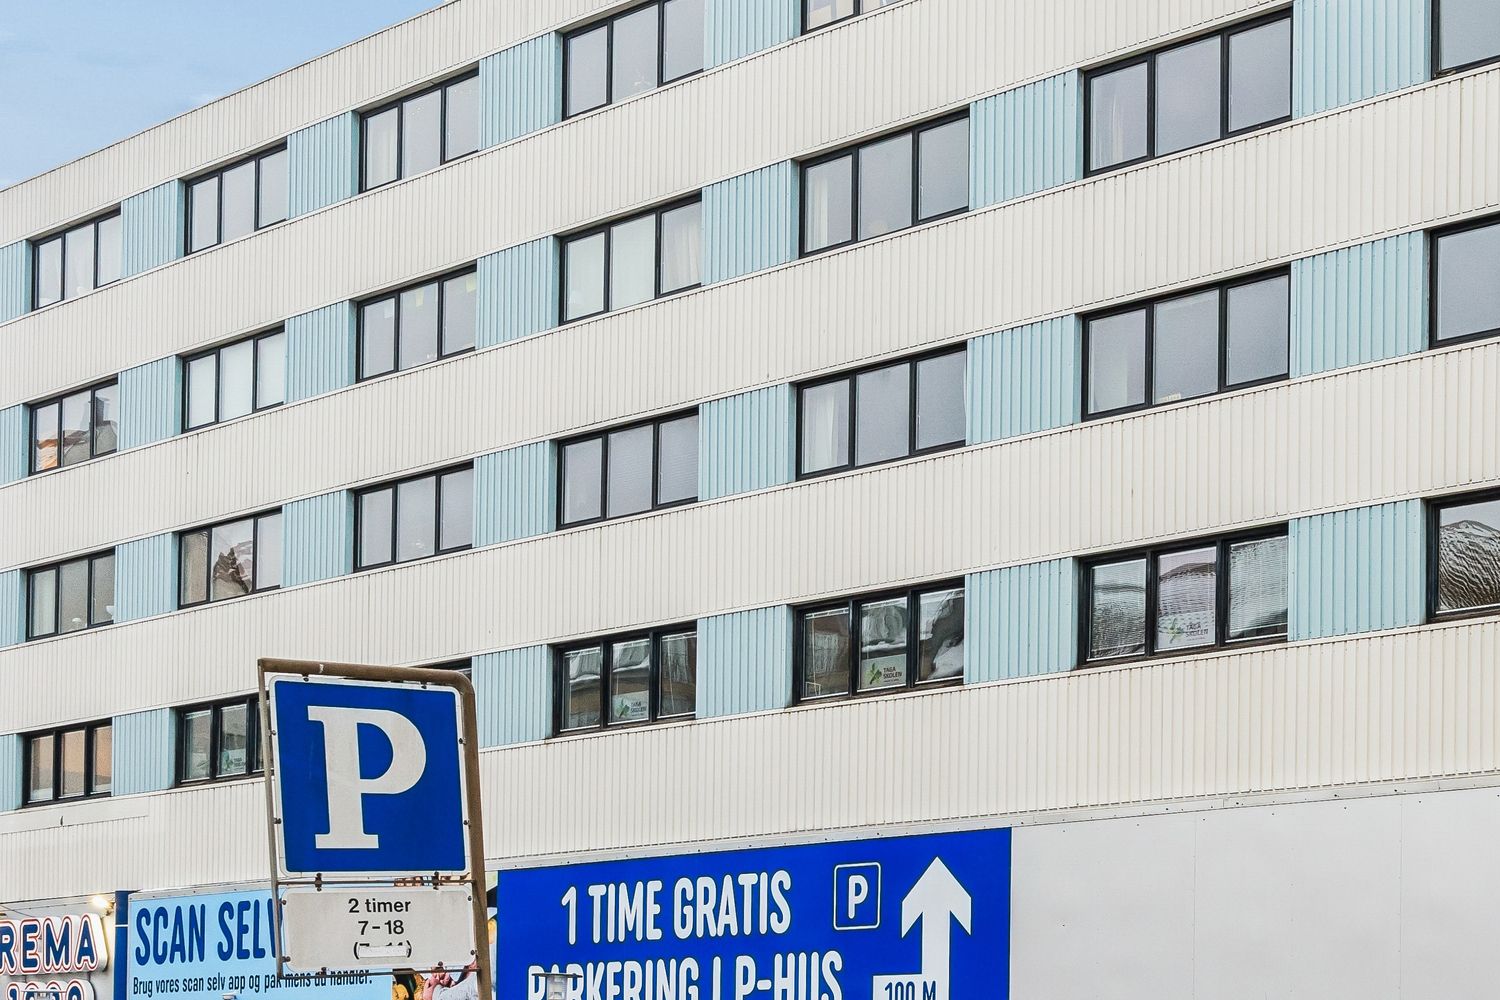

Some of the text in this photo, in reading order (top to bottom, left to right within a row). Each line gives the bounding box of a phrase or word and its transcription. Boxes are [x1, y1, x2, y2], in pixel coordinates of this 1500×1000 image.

[307, 705, 427, 849] P
[348, 898, 411, 913] 2 timer
[561, 870, 791, 944] 1 TIME GRATIS
[848, 875, 868, 919] P
[135, 904, 206, 966] SCAN
[133, 976, 153, 998] Brug
[155, 977, 179, 993] vores
[182, 976, 204, 992] scan
[207, 972, 225, 991] selv
[228, 975, 246, 993] app
[249, 975, 260, 993] og
